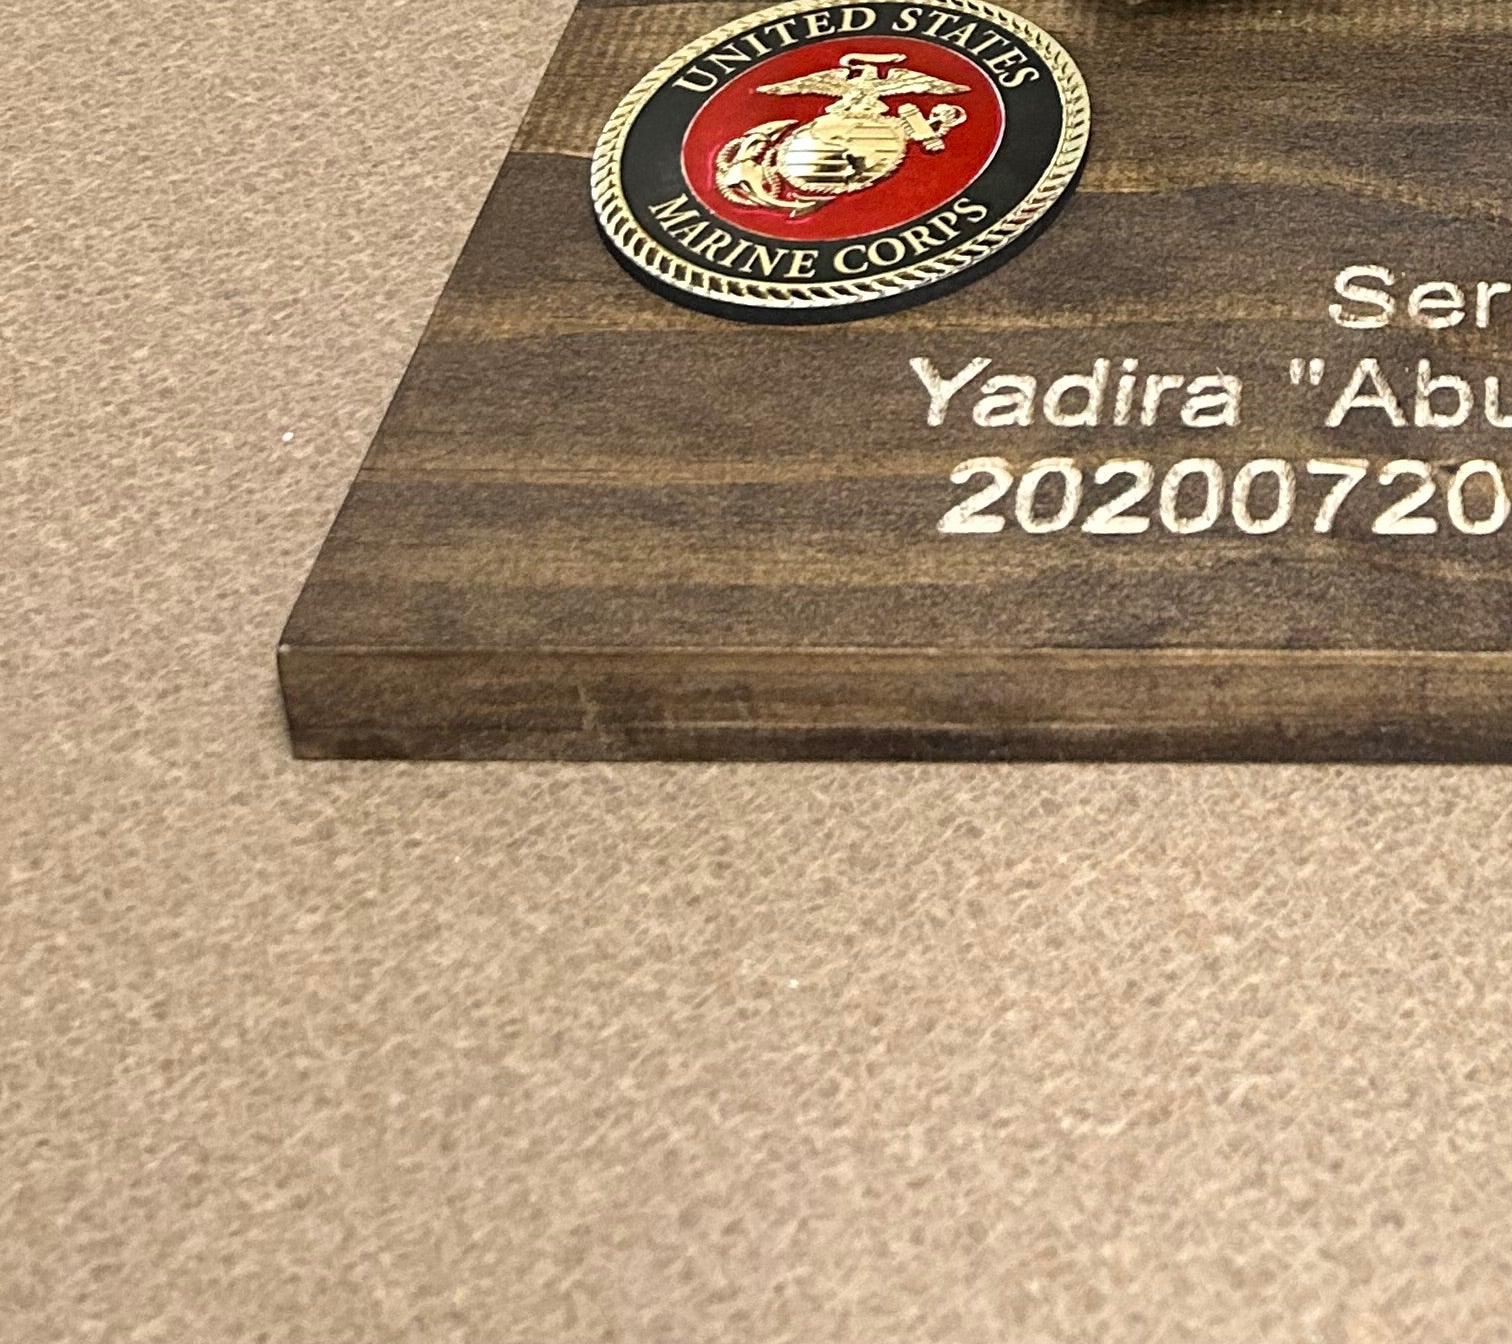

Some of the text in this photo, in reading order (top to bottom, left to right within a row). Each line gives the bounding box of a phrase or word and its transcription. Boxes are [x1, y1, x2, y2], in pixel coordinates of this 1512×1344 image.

[672, 6, 1041, 94] UNITED STATES
[647, 191, 989, 280] MARINE CORPS
[908, 355, 1243, 430] Yadira
[935, 456, 1512, 536] 20200720
